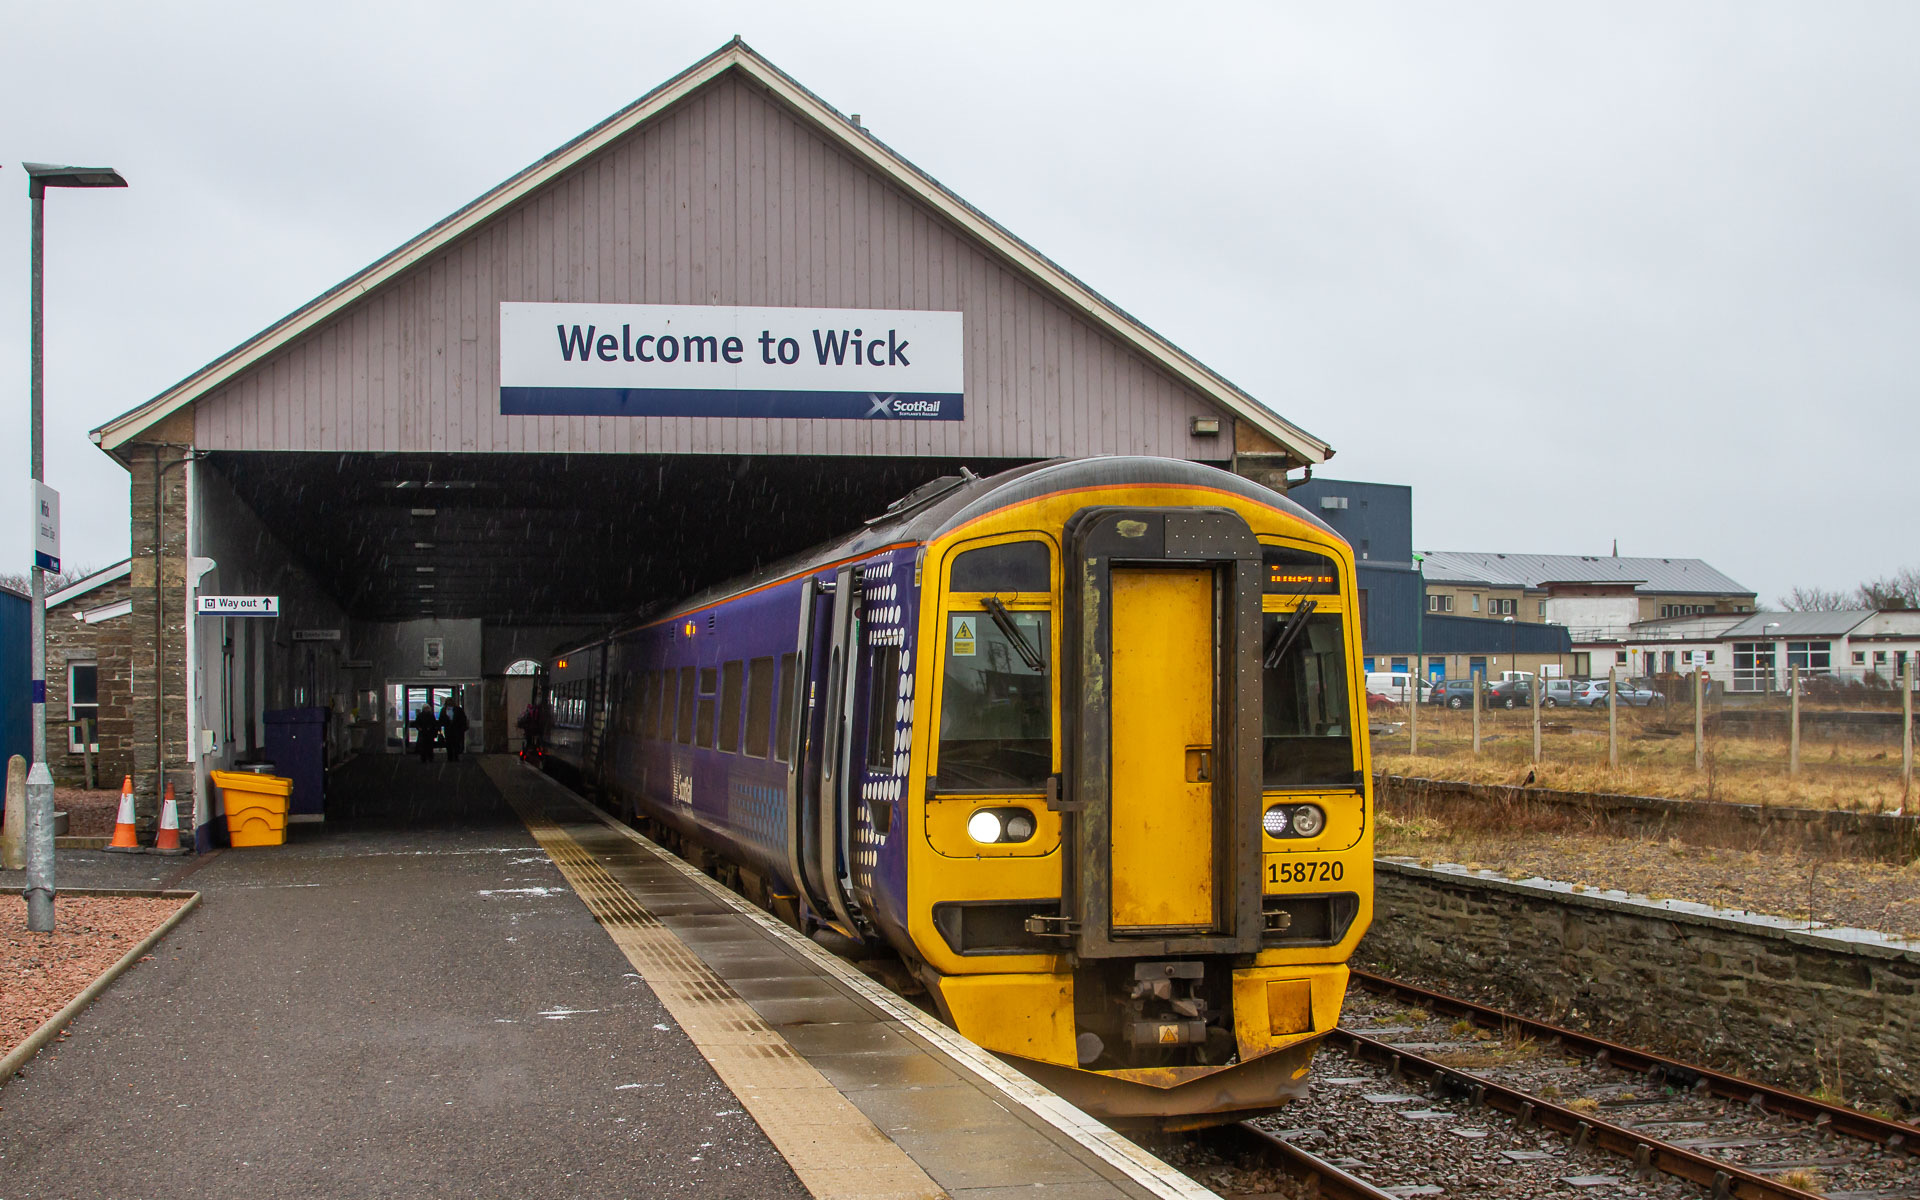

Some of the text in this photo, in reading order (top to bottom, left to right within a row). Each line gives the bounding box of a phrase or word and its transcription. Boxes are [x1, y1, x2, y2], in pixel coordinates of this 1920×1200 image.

[557, 324, 911, 367] Welcome to Wick
[893, 400, 940, 412] ScotRail
[219, 598, 257, 609] Way out
[1268, 861, 1344, 883] 158720
